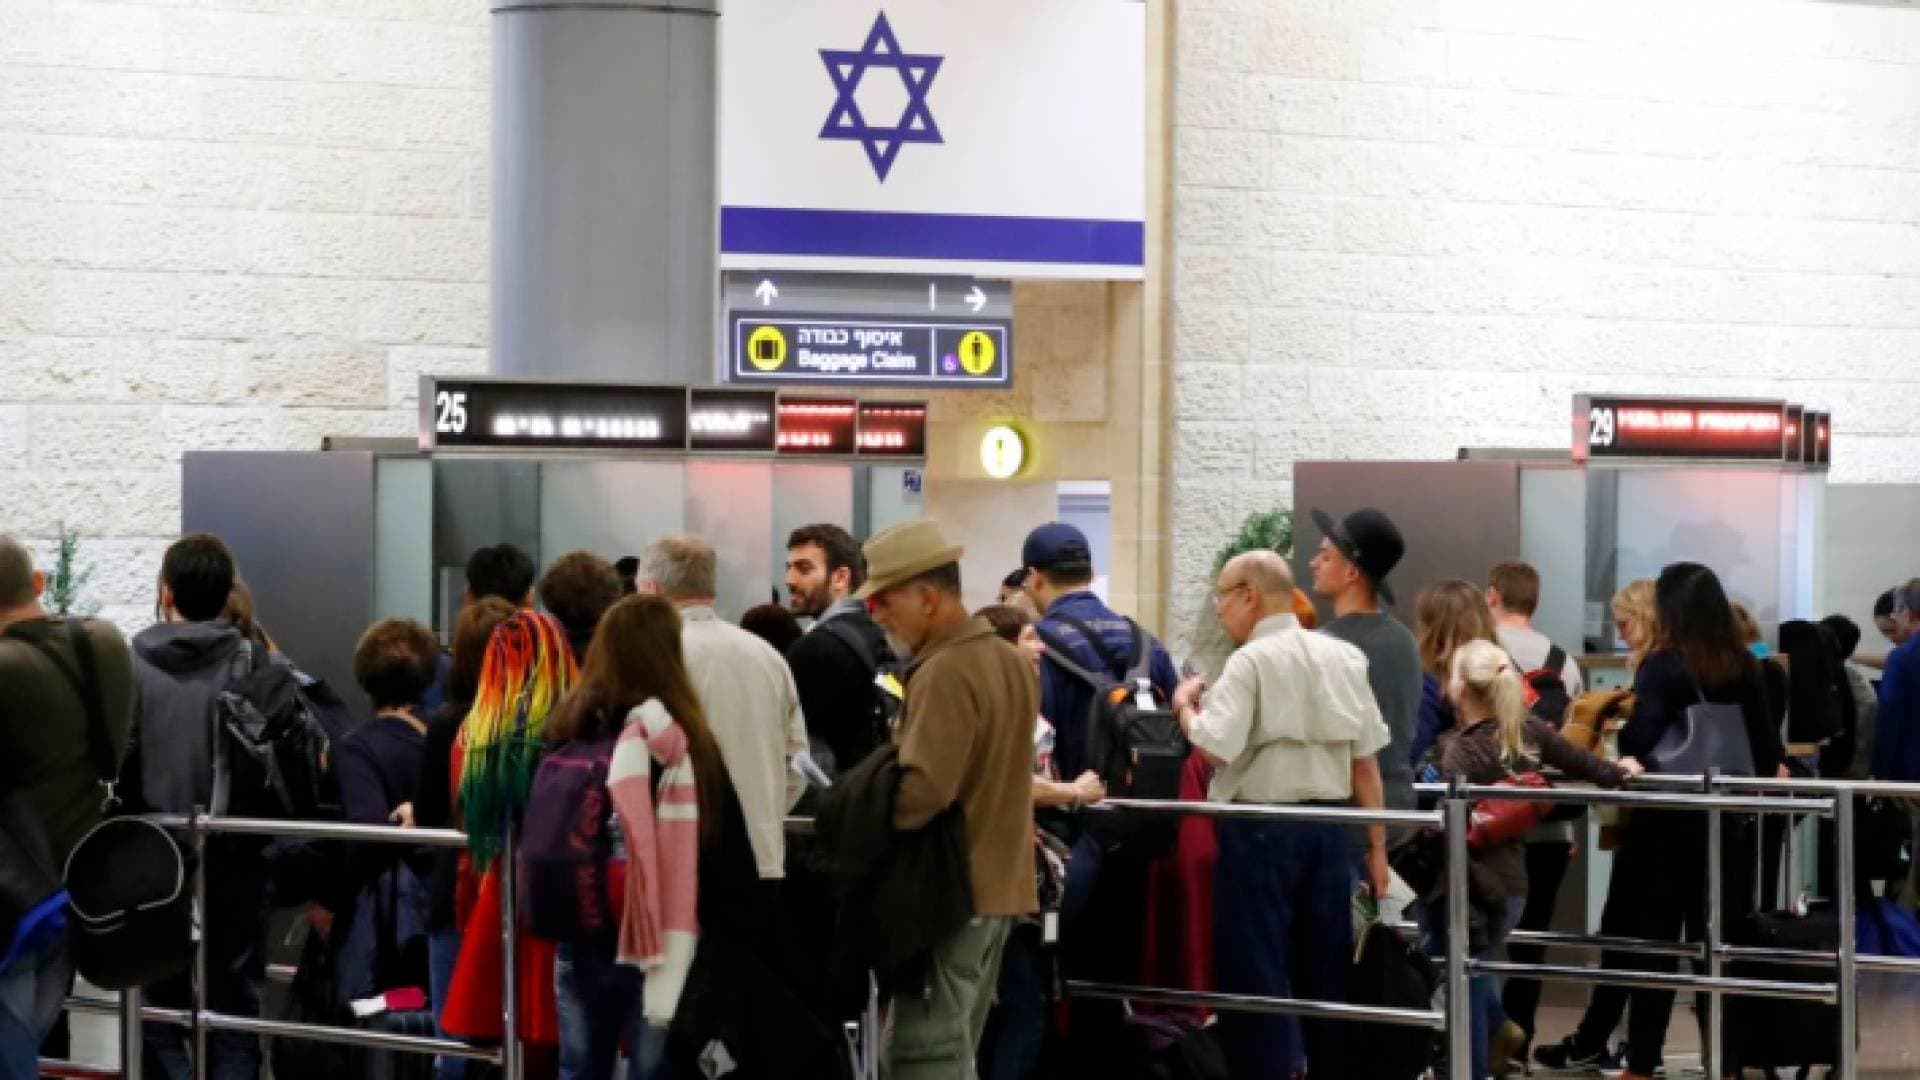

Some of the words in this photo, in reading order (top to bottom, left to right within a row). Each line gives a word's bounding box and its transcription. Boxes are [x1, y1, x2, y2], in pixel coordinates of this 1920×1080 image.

[798, 348, 868, 373] Baggage
[871, 349, 917, 369] Claim
[436, 390, 467, 433] 25
[1590, 407, 1614, 446] 29
